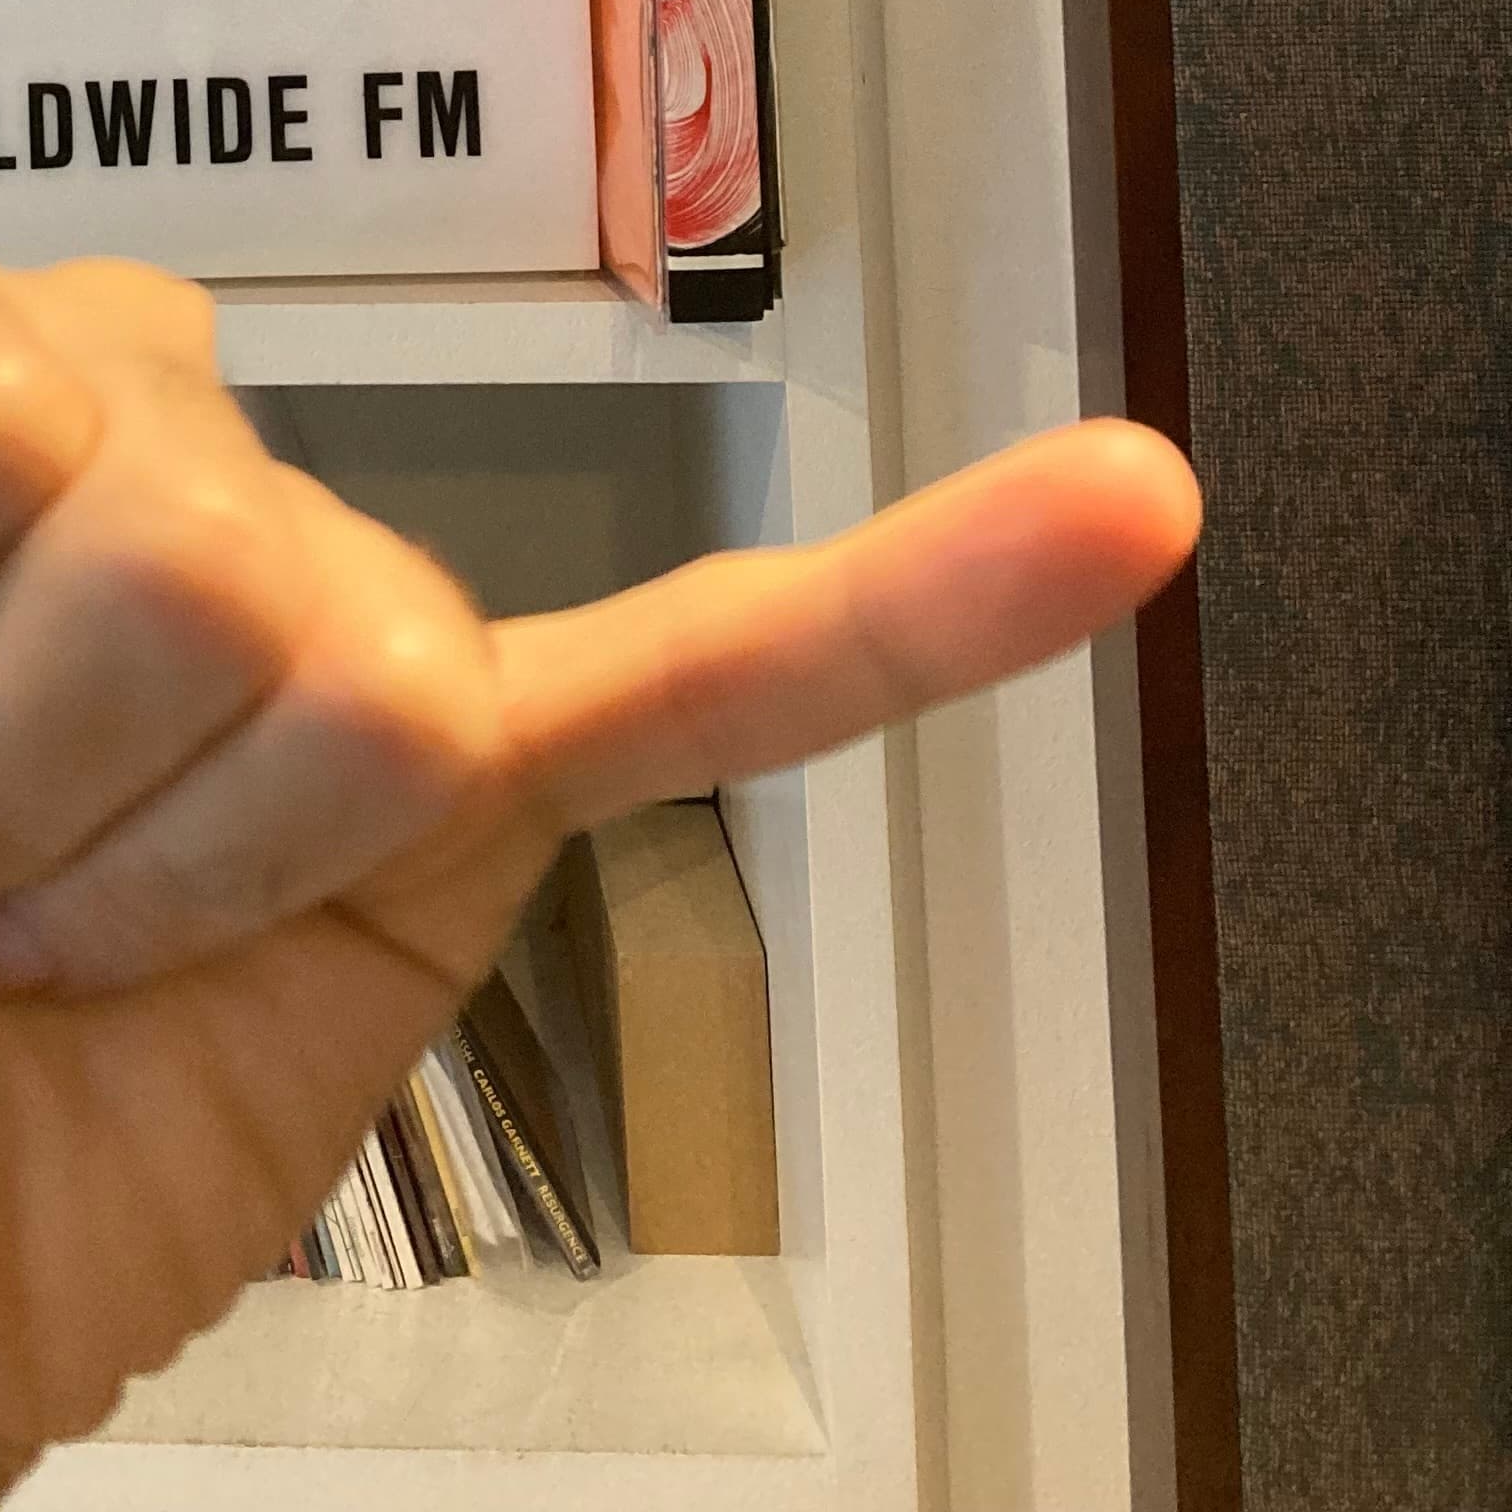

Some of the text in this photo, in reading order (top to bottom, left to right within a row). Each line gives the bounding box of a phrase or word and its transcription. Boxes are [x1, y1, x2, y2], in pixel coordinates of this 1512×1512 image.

[363, 70, 482, 159] FM
[470, 1066, 507, 1120] CARLOS
[498, 1115, 541, 1181] GARNETT
[535, 1182, 588, 1265] RESURGENCE
